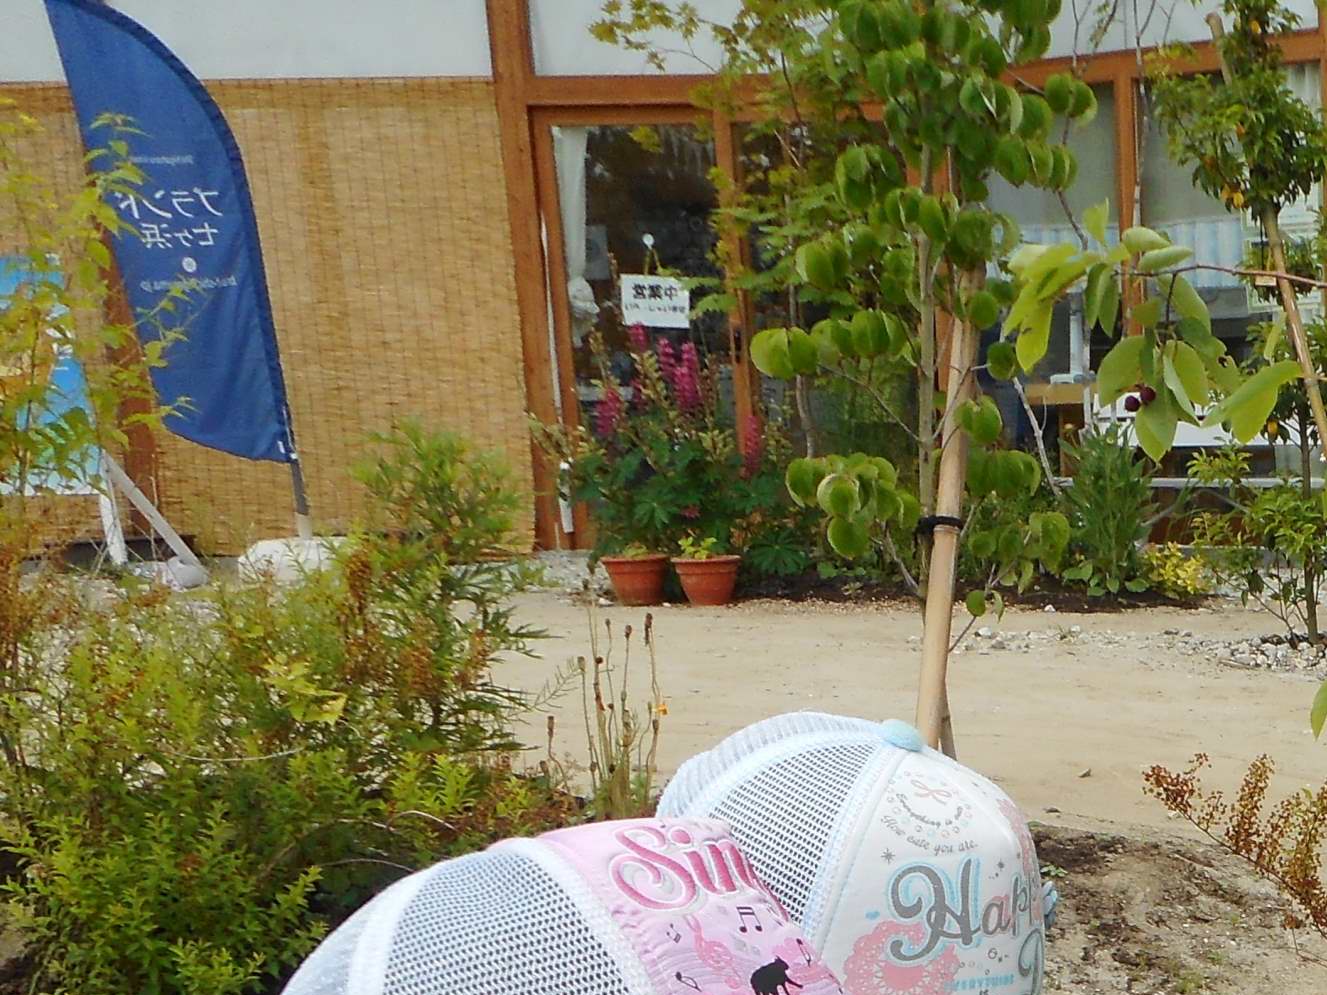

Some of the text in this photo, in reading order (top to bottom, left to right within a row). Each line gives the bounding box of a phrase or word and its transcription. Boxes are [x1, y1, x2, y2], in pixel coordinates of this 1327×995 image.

[632, 282, 678, 301] 営業中
[611, 826, 772, 912] Sin
